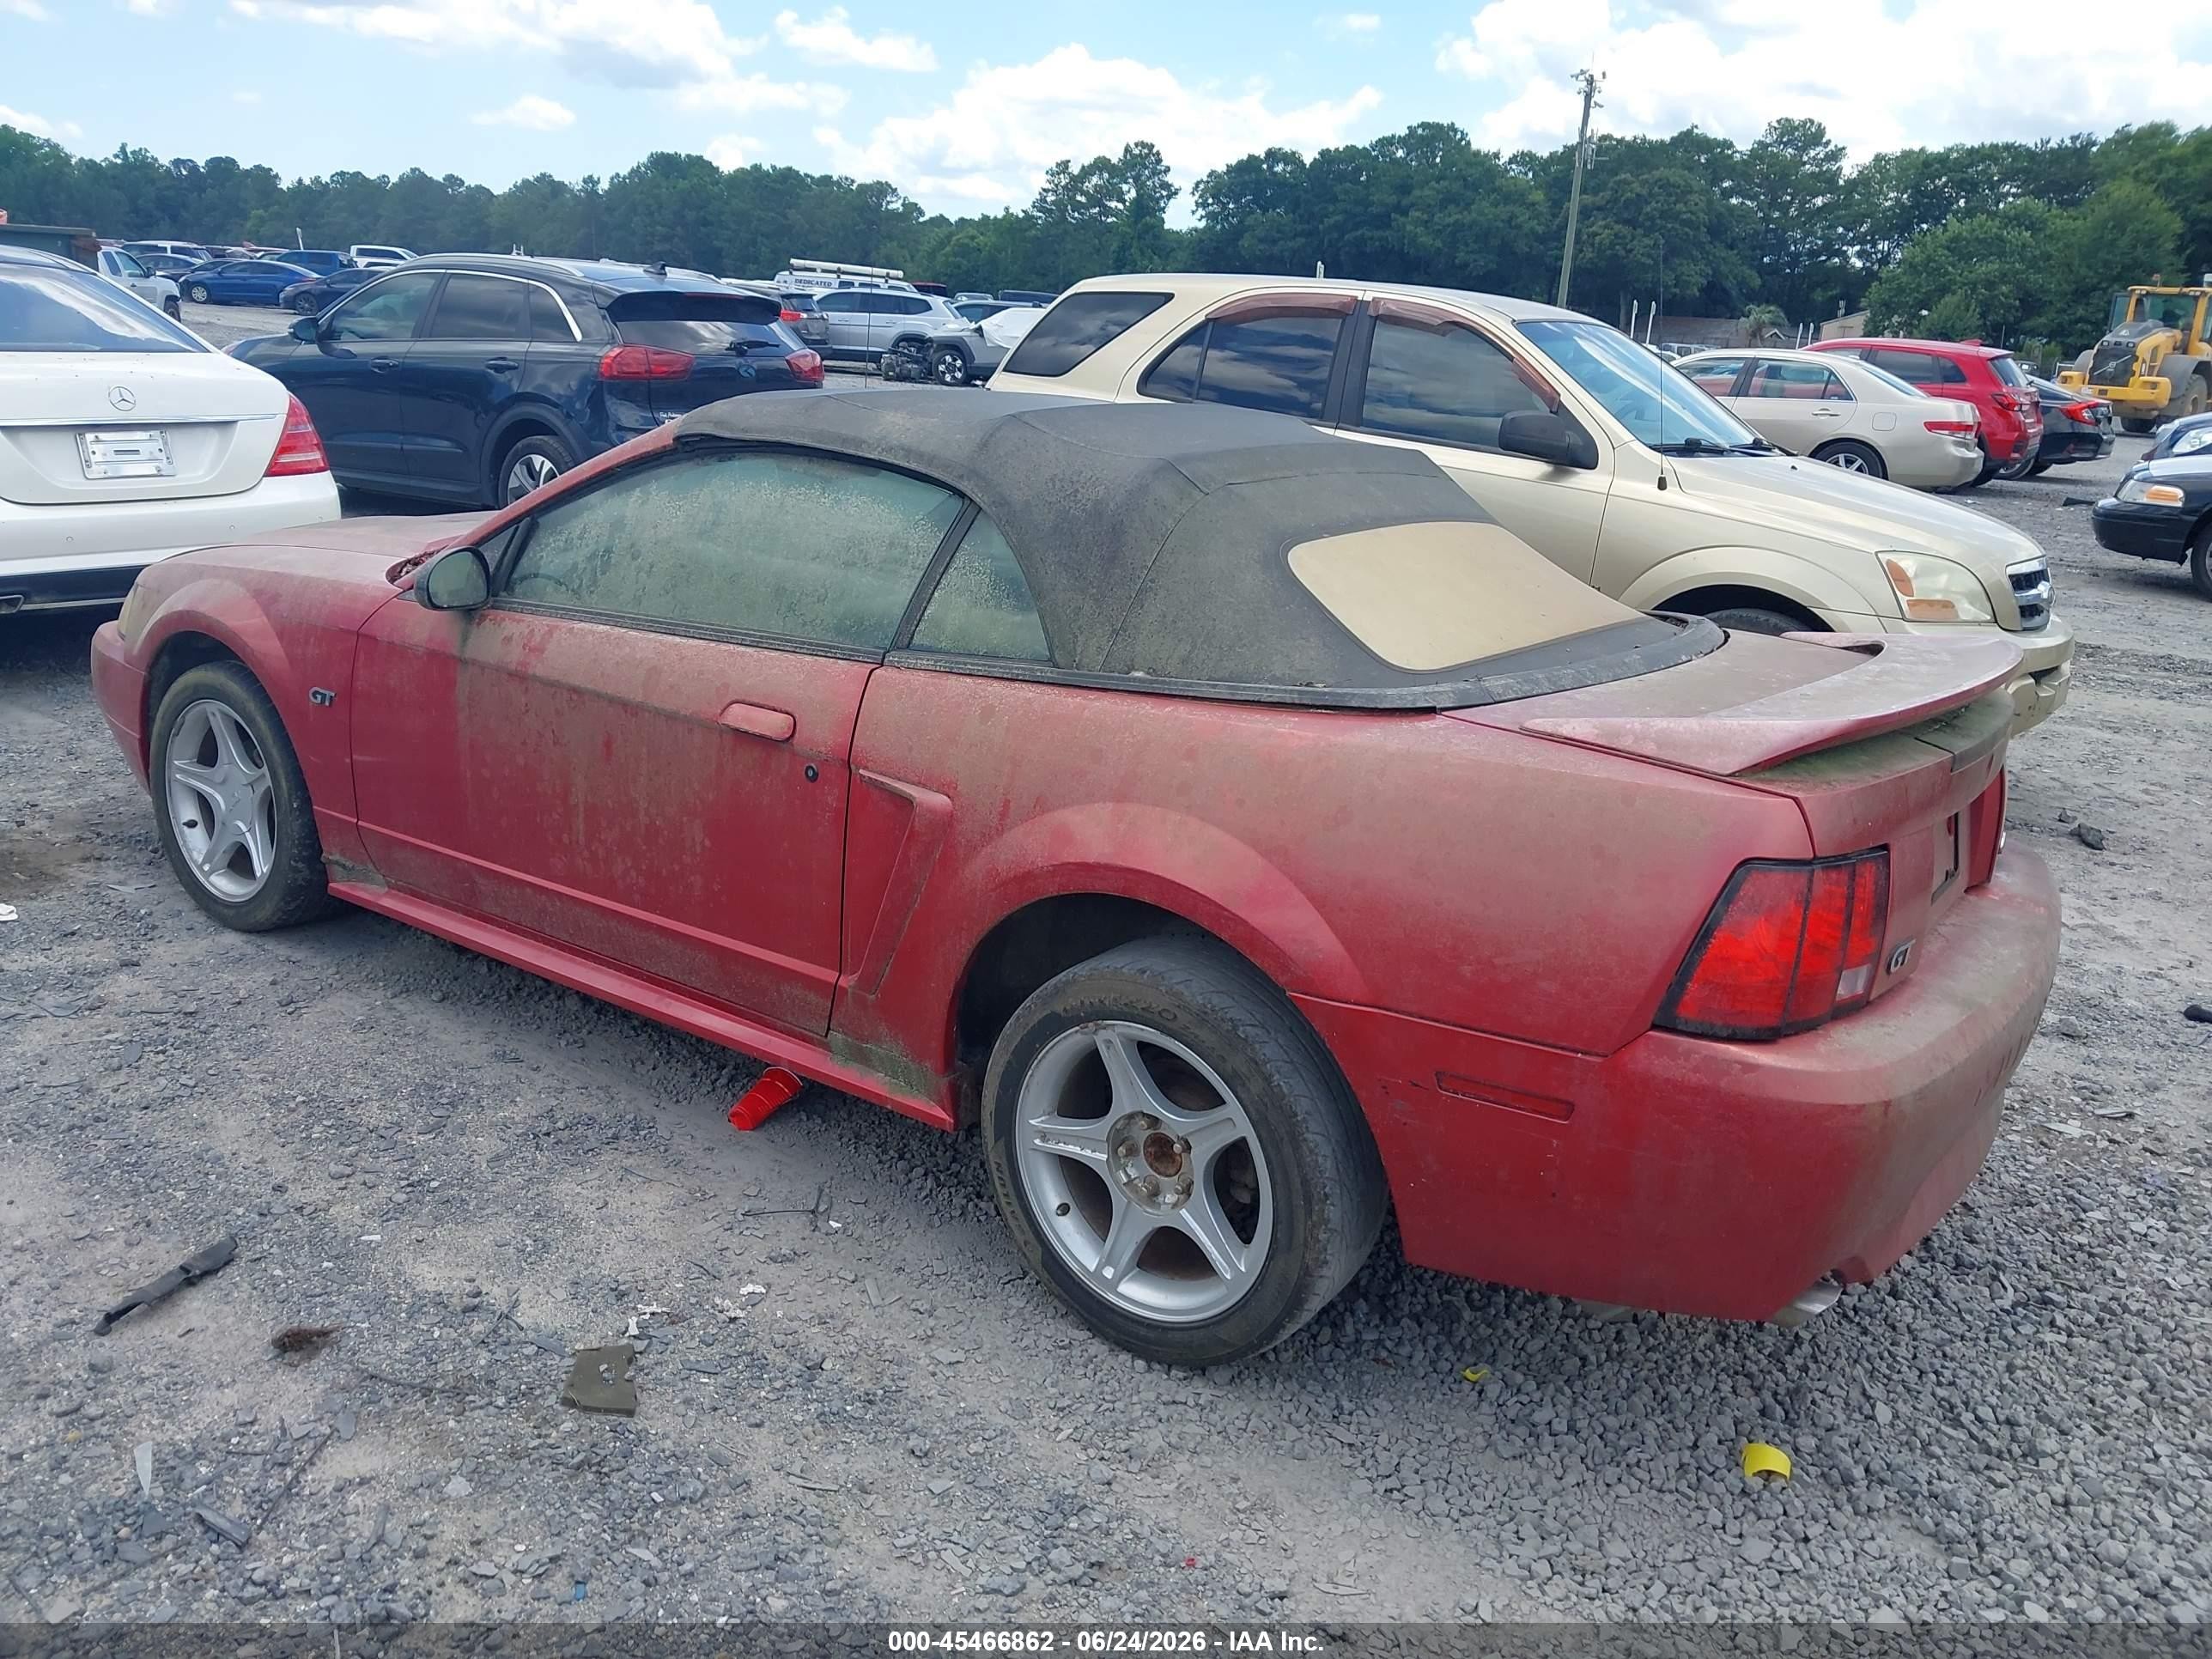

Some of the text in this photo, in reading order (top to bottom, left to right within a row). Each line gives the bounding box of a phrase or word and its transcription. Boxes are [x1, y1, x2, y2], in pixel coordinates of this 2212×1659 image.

[794, 278, 833, 287] DEDICATED
[309, 686, 336, 707] GT
[1888, 939, 1916, 973] GT
